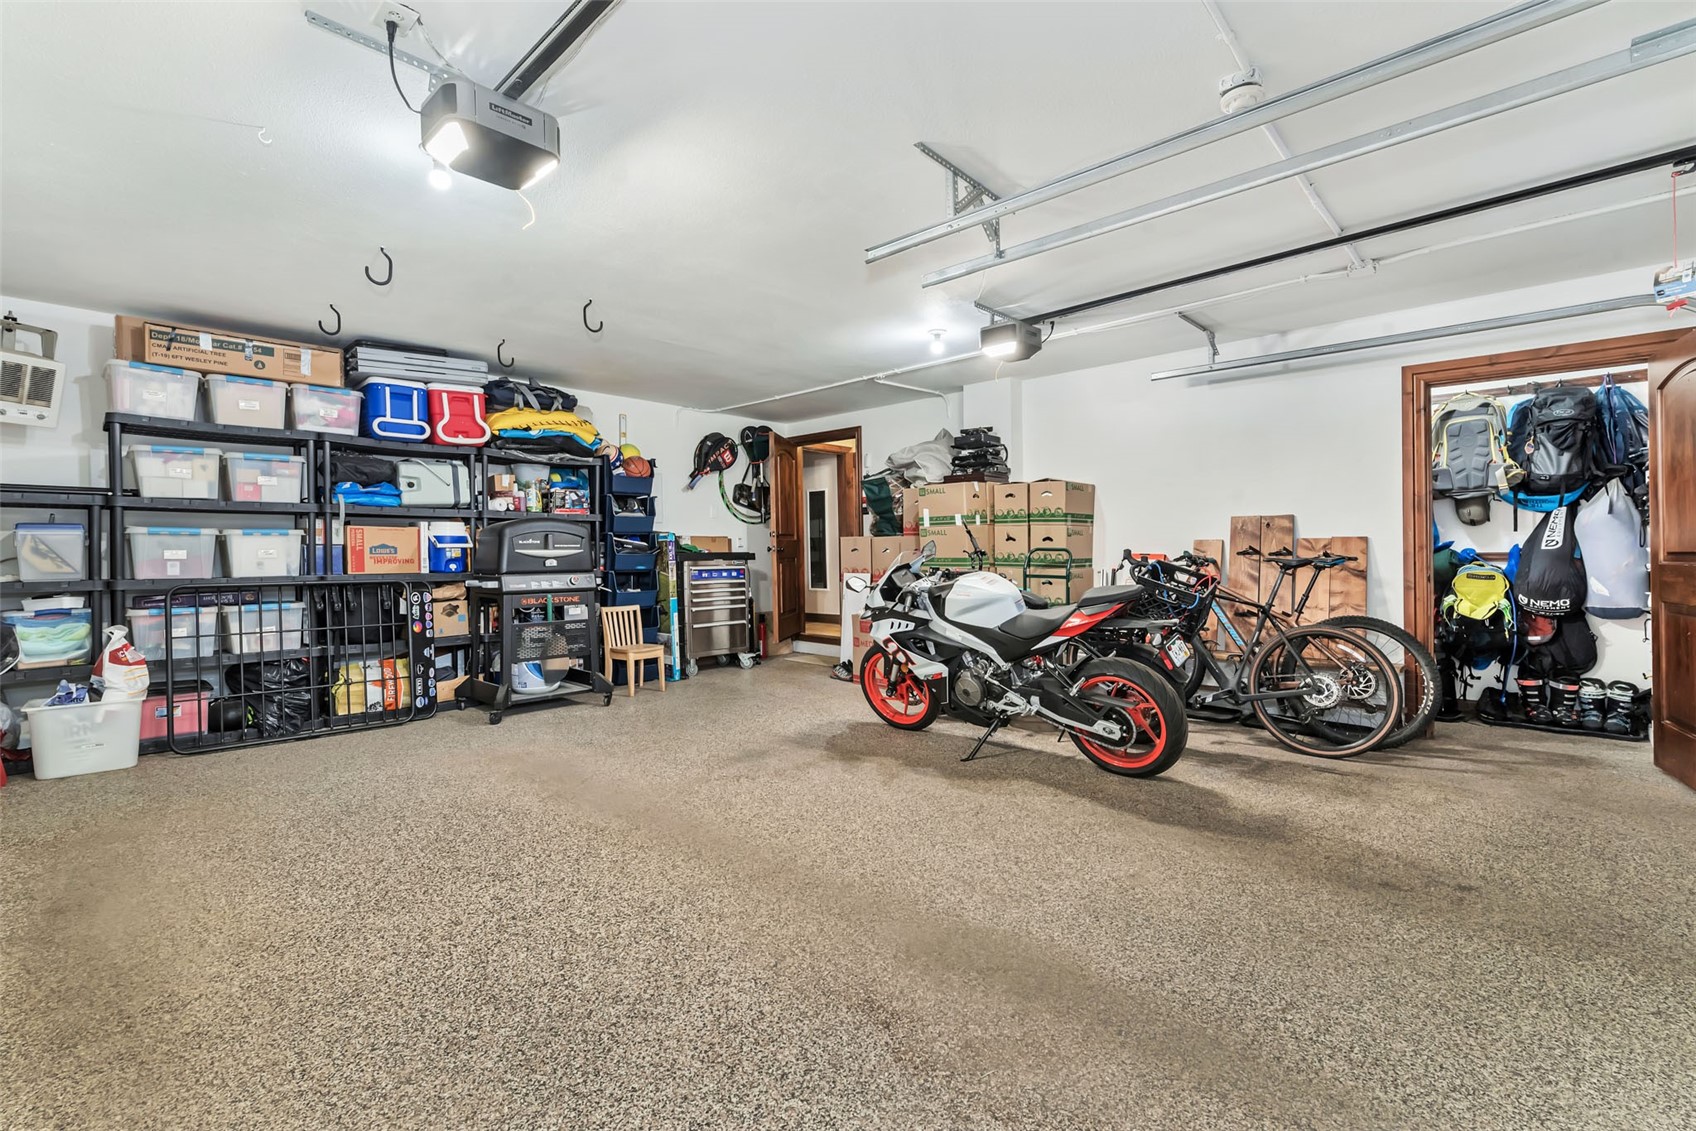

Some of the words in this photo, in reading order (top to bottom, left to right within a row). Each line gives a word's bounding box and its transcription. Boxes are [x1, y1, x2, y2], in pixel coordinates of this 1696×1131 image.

[173, 345, 208, 356] ARTIFICIAL
[185, 356, 212, 364] WESLEY
[355, 529, 363, 551] SMALL
[1529, 598, 1570, 607] NEMO
